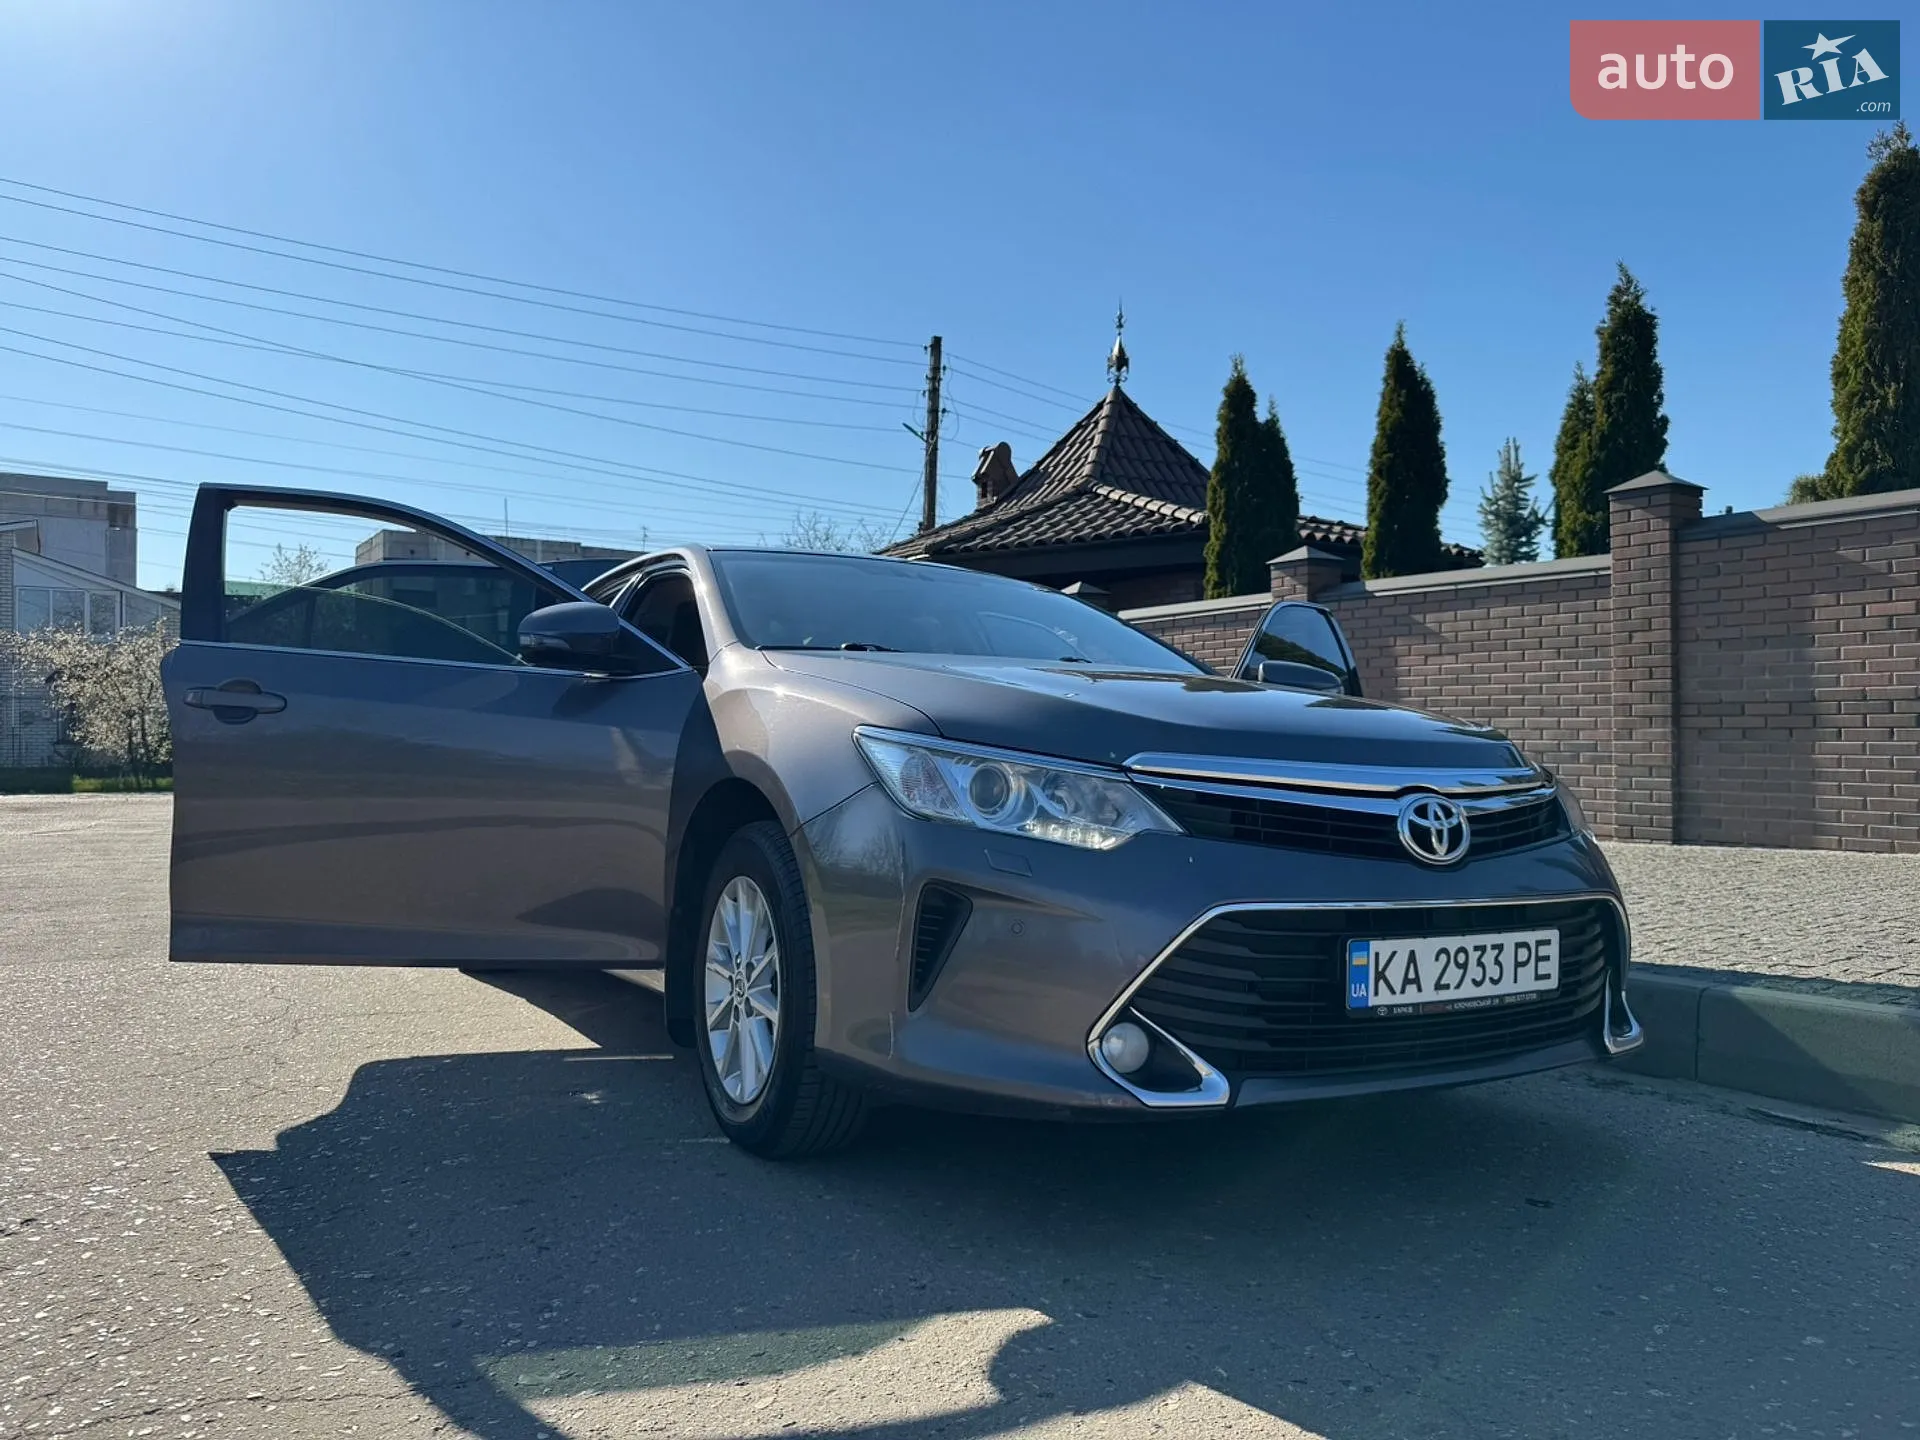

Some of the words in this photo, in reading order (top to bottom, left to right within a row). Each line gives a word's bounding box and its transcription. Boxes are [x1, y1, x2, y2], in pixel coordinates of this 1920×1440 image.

[1373, 949, 1423, 997] KA
[1433, 942, 1505, 992] 2933
[1512, 938, 1553, 984] PE
[1351, 983, 1367, 998] UA
